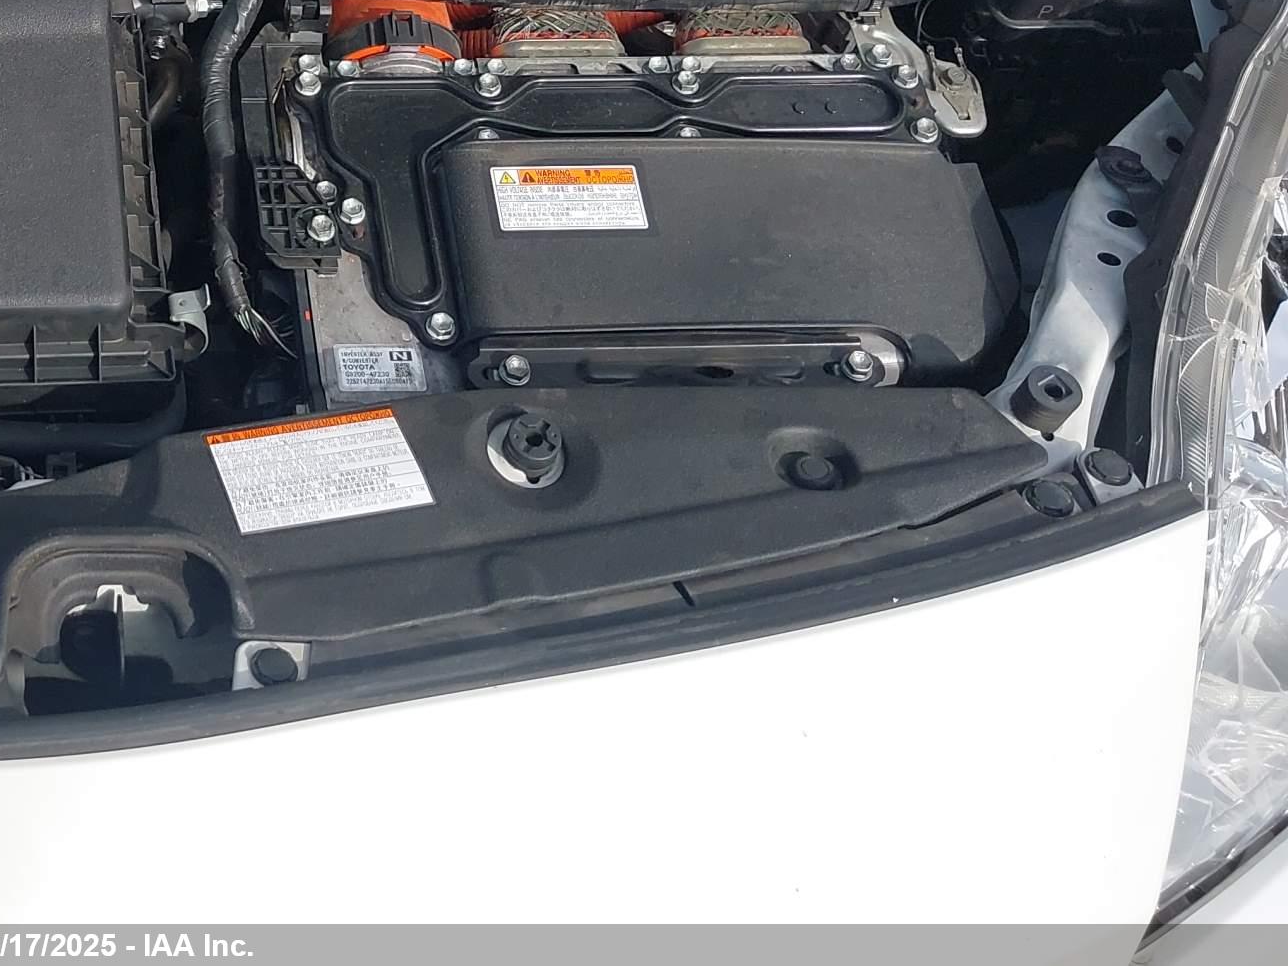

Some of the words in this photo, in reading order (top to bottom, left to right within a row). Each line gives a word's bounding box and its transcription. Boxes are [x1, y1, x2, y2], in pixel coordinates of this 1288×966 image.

[1037, 5, 1054, 19] P
[535, 169, 571, 177] WARNING
[392, 351, 409, 361] N
